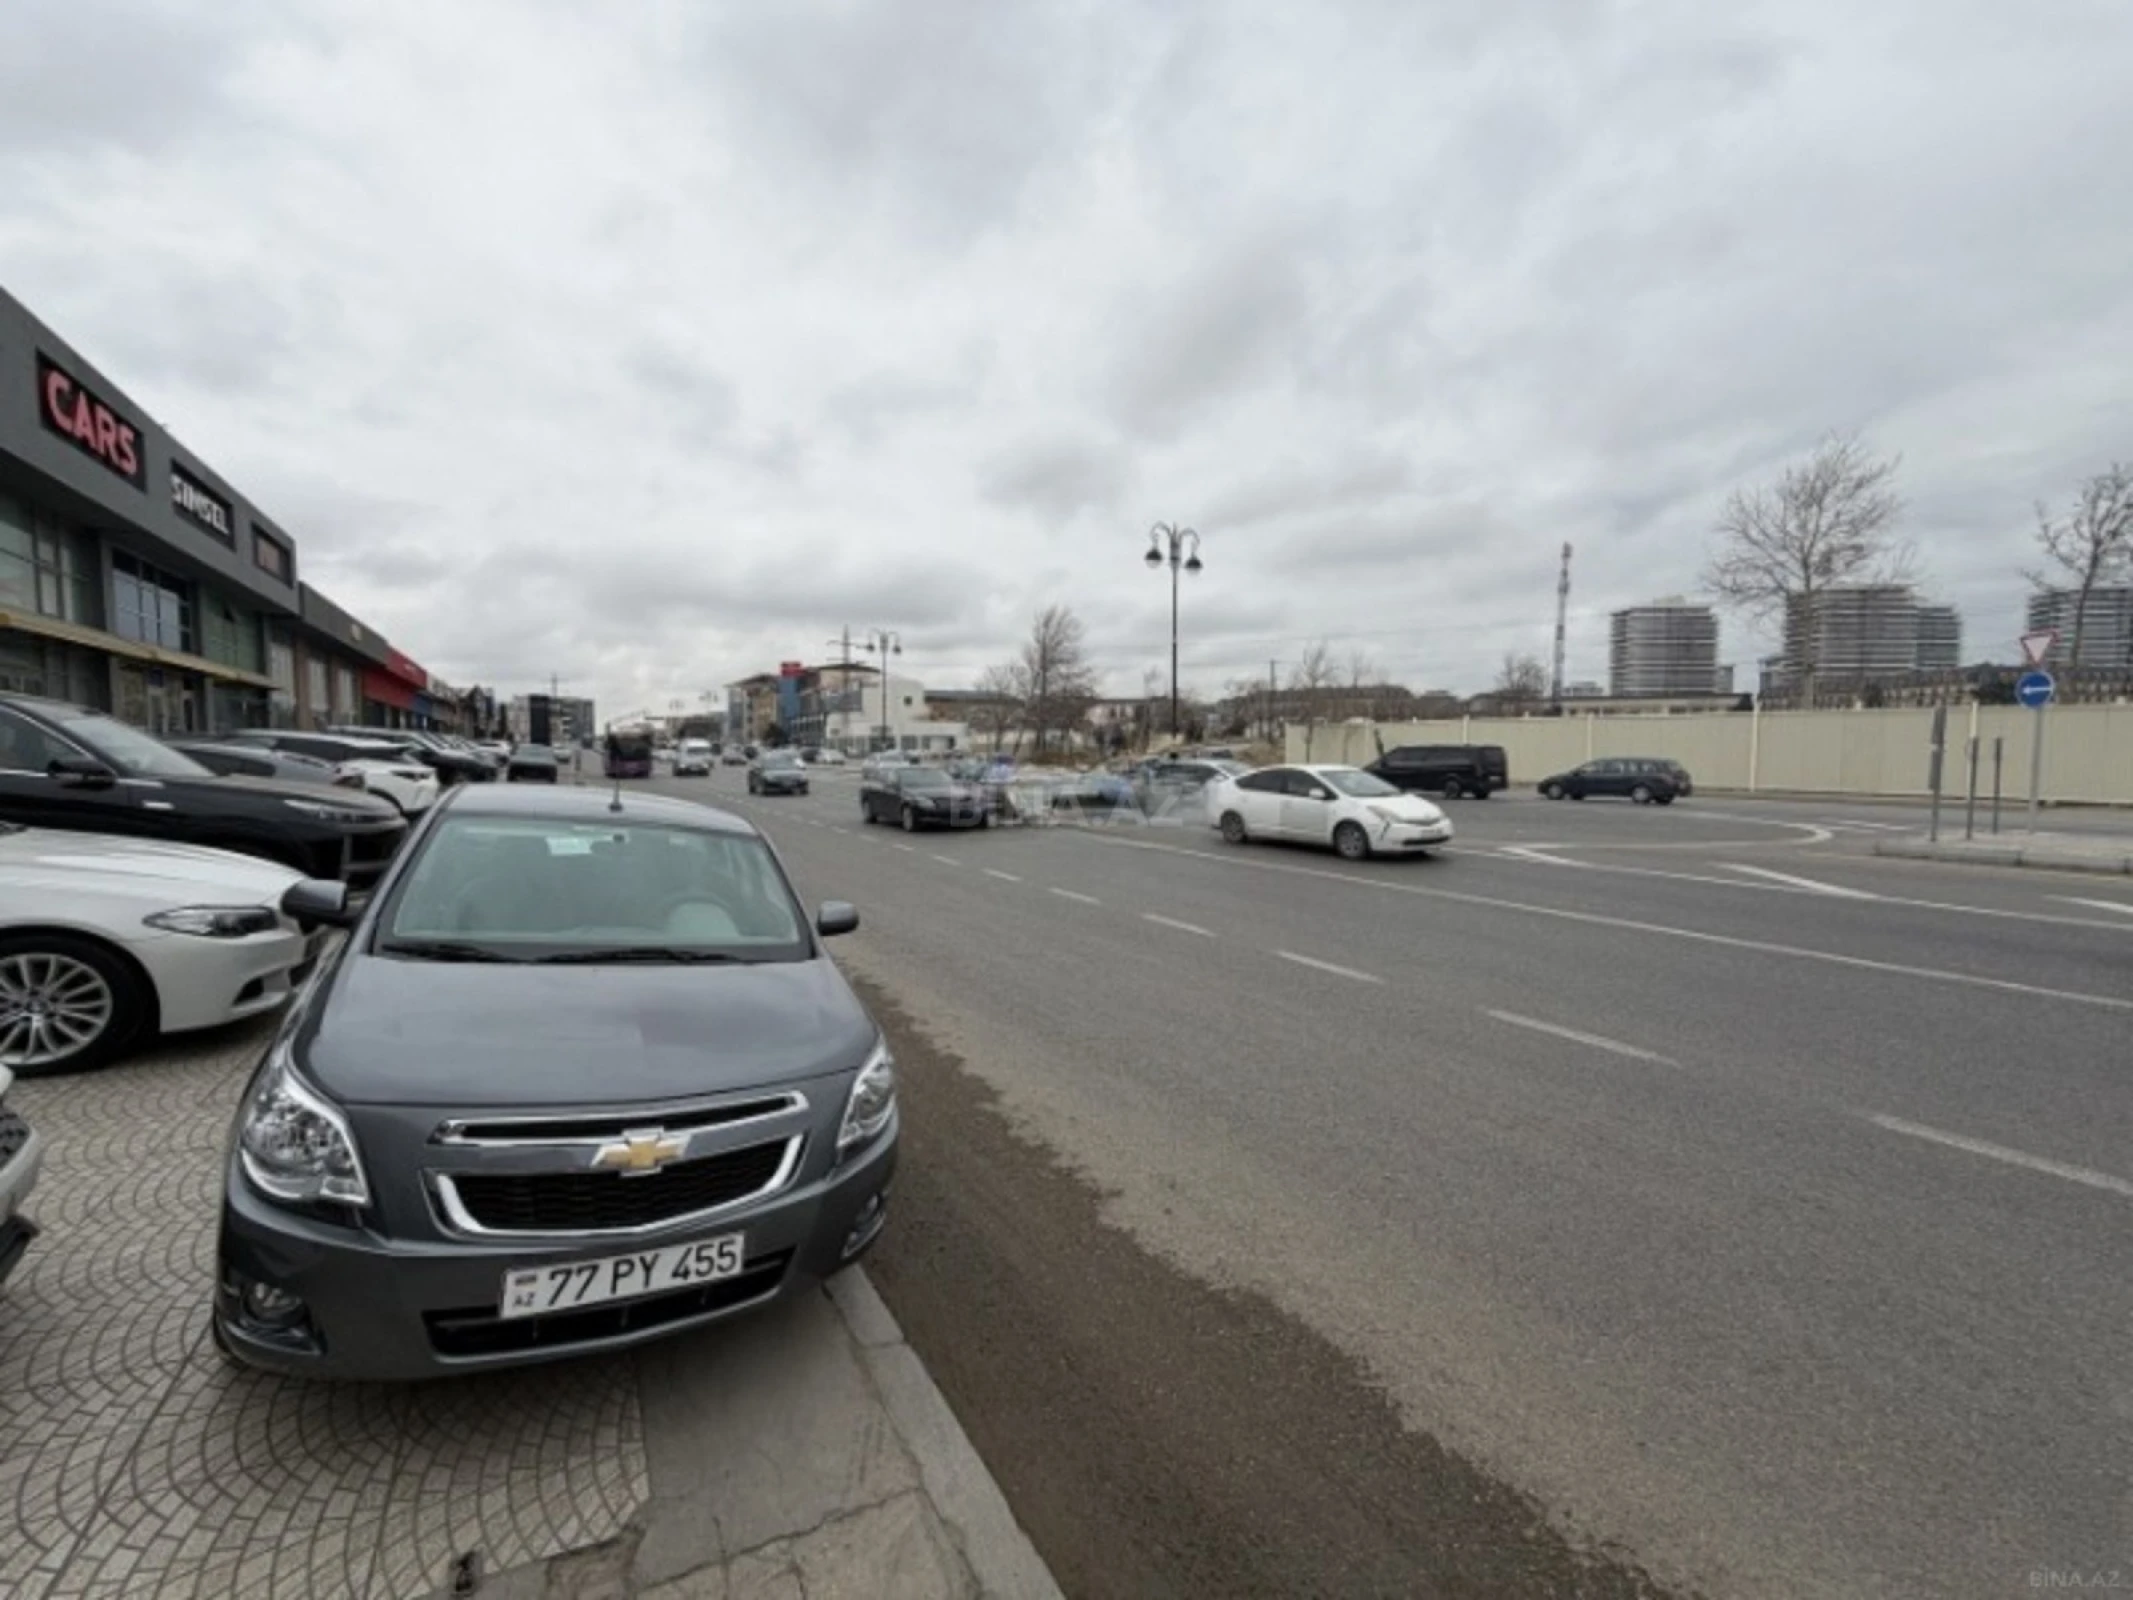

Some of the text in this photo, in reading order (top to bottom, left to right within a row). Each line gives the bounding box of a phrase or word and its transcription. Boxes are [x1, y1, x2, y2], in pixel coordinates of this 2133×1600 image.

[47, 369, 137, 475] CARS
[513, 1291, 535, 1307] AZ
[548, 1239, 737, 1306] 77 PY 455
